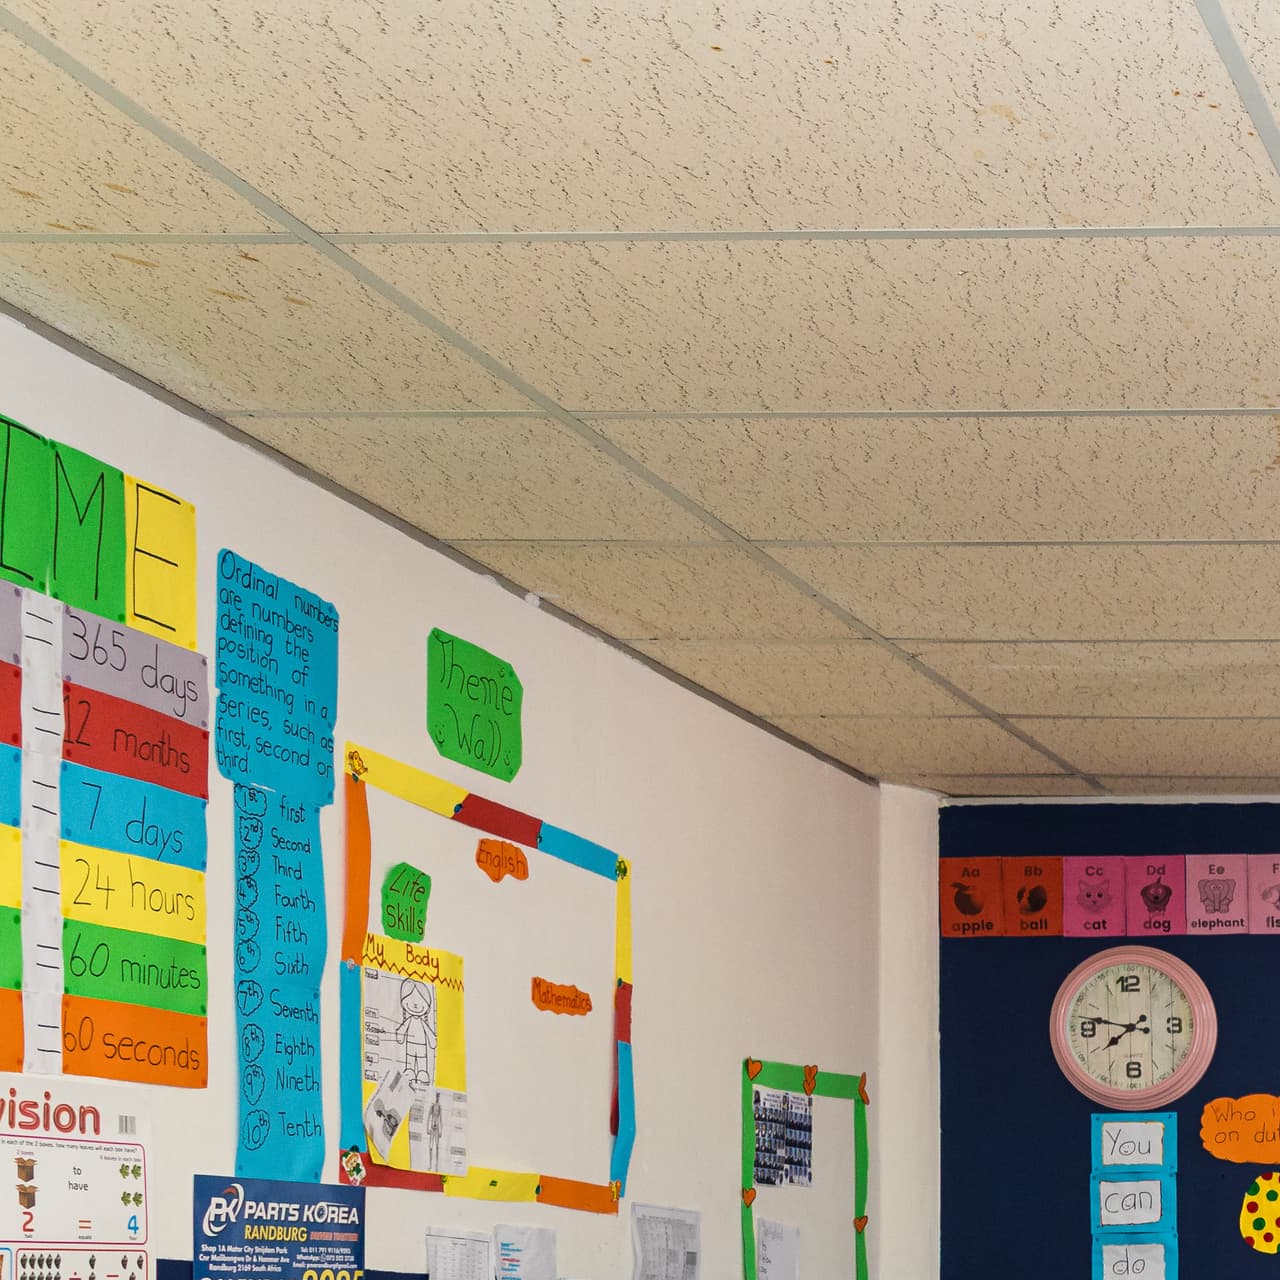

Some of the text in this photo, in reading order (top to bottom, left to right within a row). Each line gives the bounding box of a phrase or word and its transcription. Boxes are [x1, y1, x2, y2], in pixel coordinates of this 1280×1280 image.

[221, 551, 339, 633] Ordinal numbers
[220, 588, 314, 643] are numbers
[221, 611, 309, 662] defining the
[69, 614, 199, 718] 365 days
[218, 637, 310, 687] position of
[431, 630, 513, 716] Theme
[304, 695, 316, 716] in
[321, 705, 328, 720] a
[64, 695, 190, 774] 12 months
[218, 718, 332, 778] first, second or
[284, 719, 315, 744] such
[321, 735, 334, 754] as
[443, 702, 502, 768] Wall
[217, 744, 251, 774] third.
[81, 781, 183, 861] 7 days
[271, 827, 311, 854] Second
[272, 855, 303, 880] Third
[476, 841, 527, 878] English
[73, 858, 195, 921] 24 hours
[274, 884, 316, 913] Fourth
[389, 869, 426, 903] Life
[276, 916, 308, 945] Fifth
[386, 903, 425, 937] Skills
[1191, 916, 1245, 931] elephant
[70, 933, 201, 990] 60 minutes
[274, 952, 309, 976] Sixth
[366, 933, 440, 979] My Body
[532, 977, 593, 1014] Mathematics
[1115, 976, 1141, 993] 12
[270, 988, 319, 1025] Seventh
[63, 1010, 200, 1071] 60 seconds
[275, 1033, 315, 1066] Eighth
[276, 1064, 320, 1092] Nineth
[0, 1087, 101, 1136] ision
[278, 1109, 321, 1137] Tenth
[1213, 1102, 1257, 1124] Who
[1105, 1128, 1151, 1158] You
[1214, 1129, 1241, 1144] on
[68, 1180, 89, 1192] have
[73, 1165, 82, 1176] to
[244, 1201, 359, 1224] PARTS KOREA
[1104, 1189, 1153, 1215] can
[244, 1225, 307, 1242] RANDBURG
[1112, 1248, 1146, 1276] do
